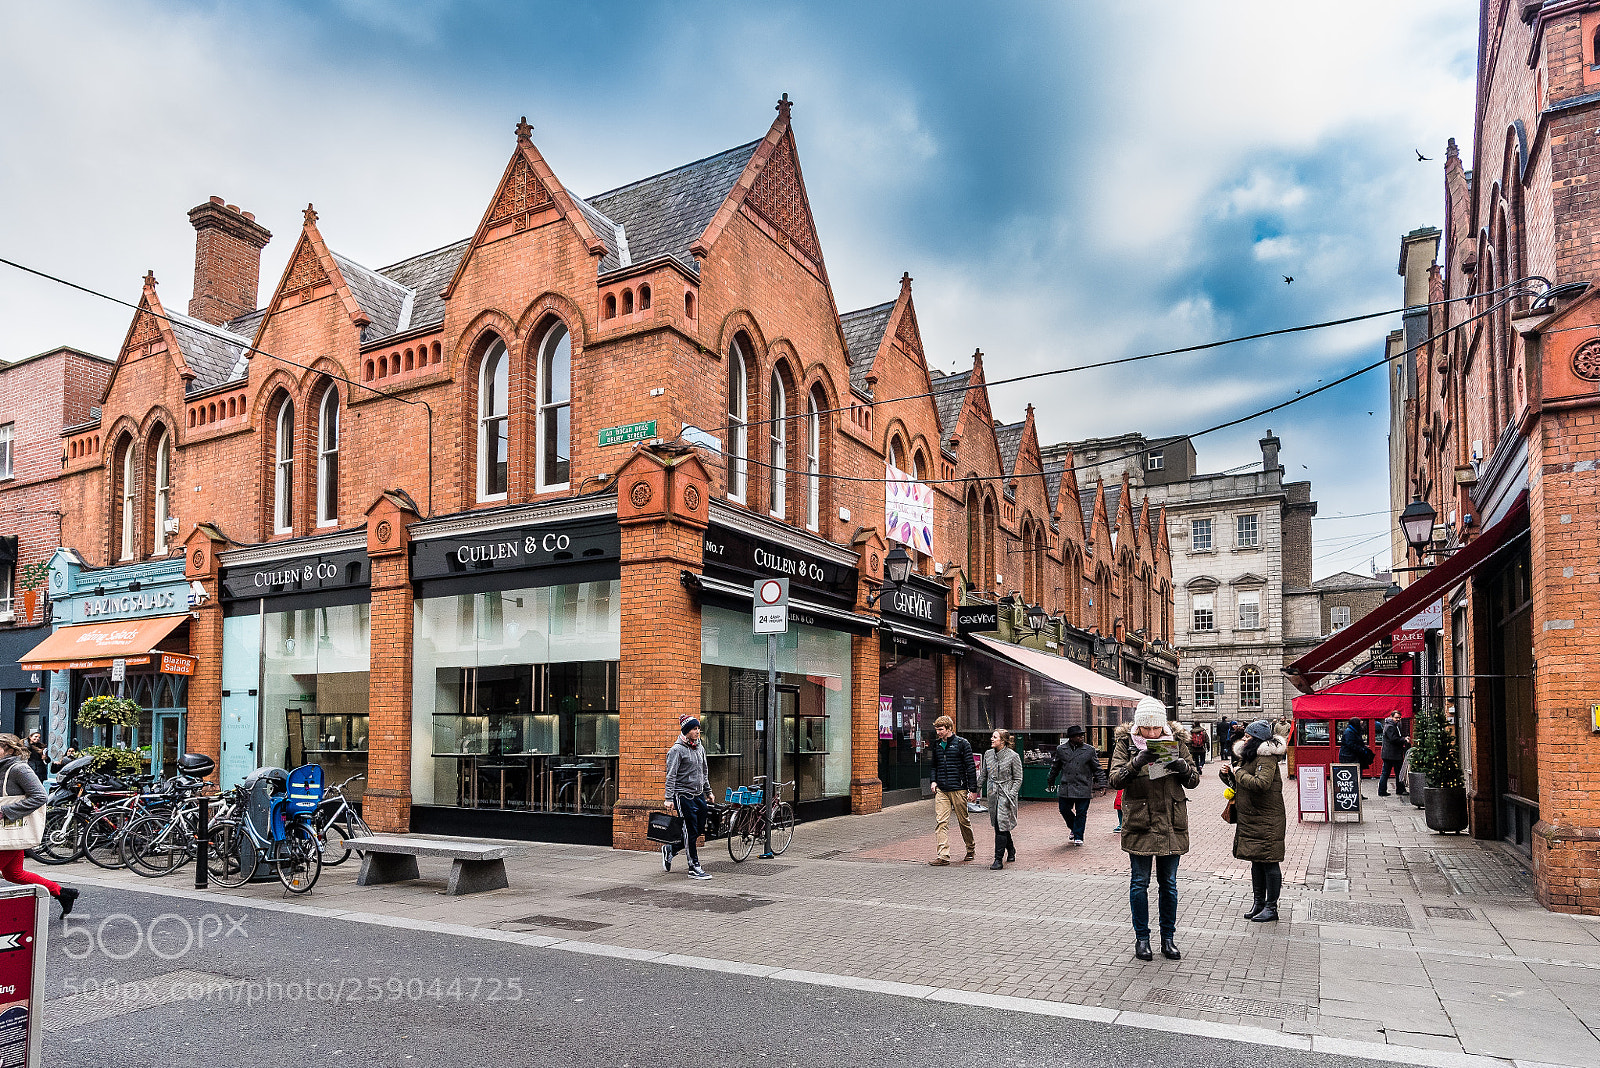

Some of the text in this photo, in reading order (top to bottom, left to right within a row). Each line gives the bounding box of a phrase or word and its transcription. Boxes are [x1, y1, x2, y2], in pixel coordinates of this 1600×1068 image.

[457, 540, 519, 563] CULLEN
[524, 536, 536, 554] &
[718, 544, 724, 555] 7
[754, 548, 796, 575] CULLEN
[798, 559, 807, 577] &
[254, 568, 300, 587] CULLEN
[303, 565, 313, 581] &
[84, 591, 175, 616] BLAZING SALADS
[759, 615, 768, 623] 24
[1392, 633, 1423, 642] RARE
[163, 655, 192, 667] Blazing
[164, 664, 190, 674] Salads
[0, 984, 16, 995] ing
